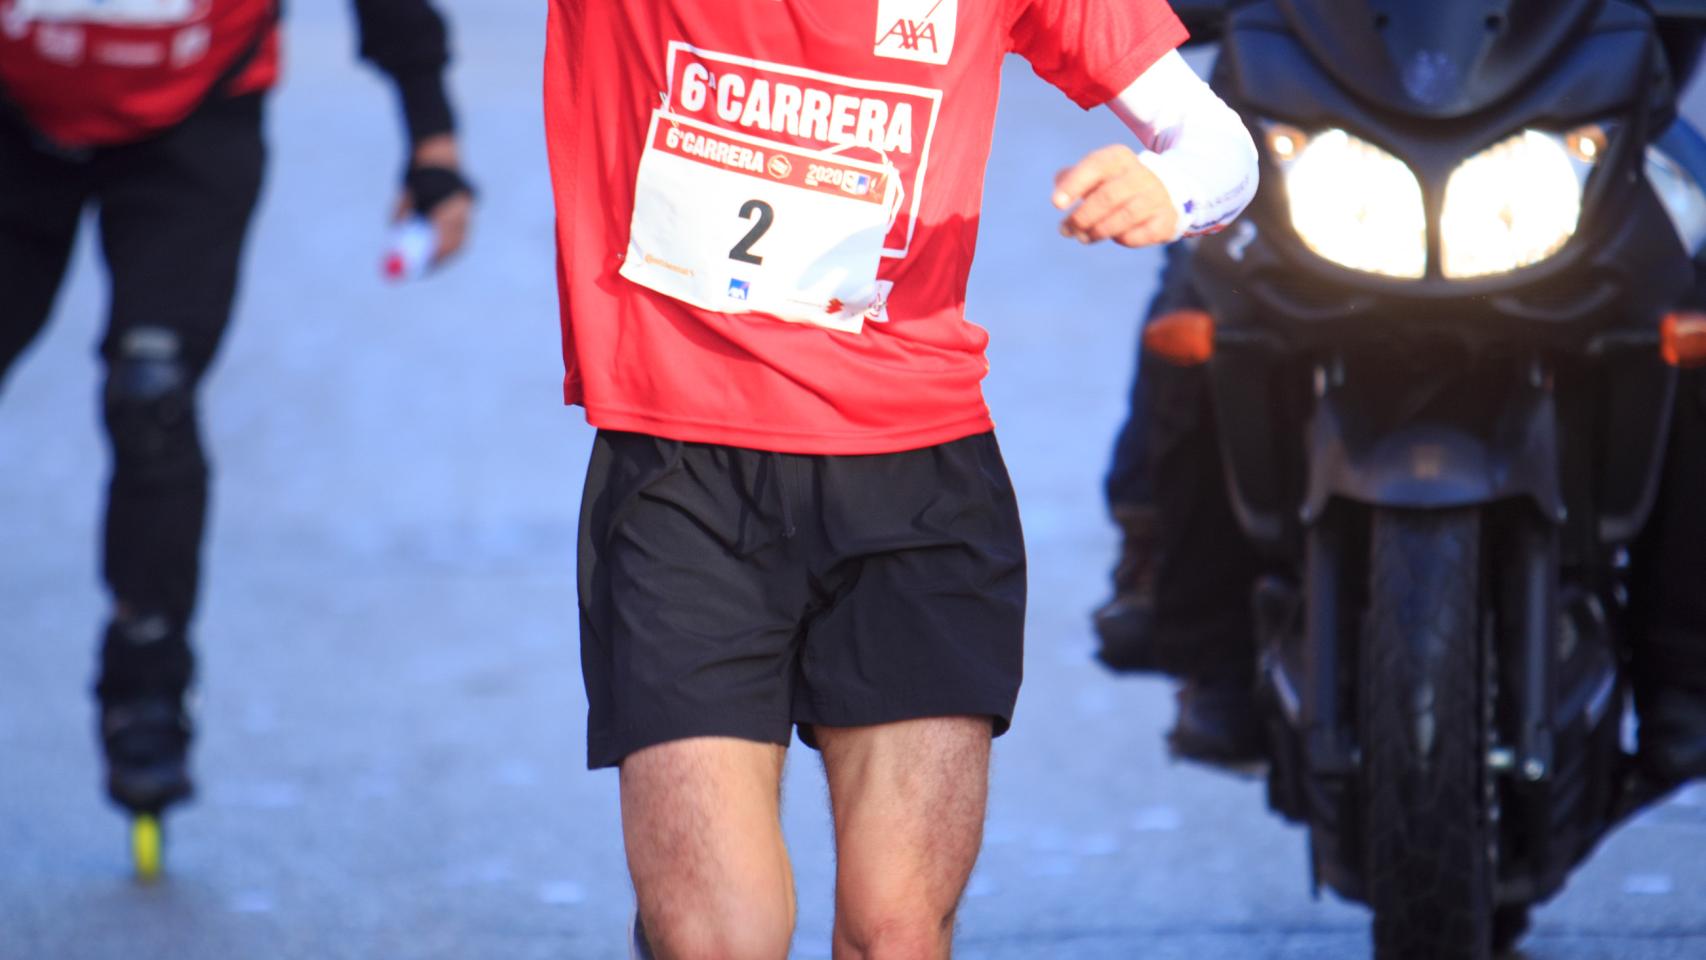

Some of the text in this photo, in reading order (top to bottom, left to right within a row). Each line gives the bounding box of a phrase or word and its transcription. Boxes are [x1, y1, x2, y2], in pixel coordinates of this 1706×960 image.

[875, 18, 938, 53] AXA
[716, 73, 912, 154] CARRERA
[681, 132, 765, 173] CARRERA
[806, 164, 843, 186] 2020
[728, 199, 774, 265] 2
